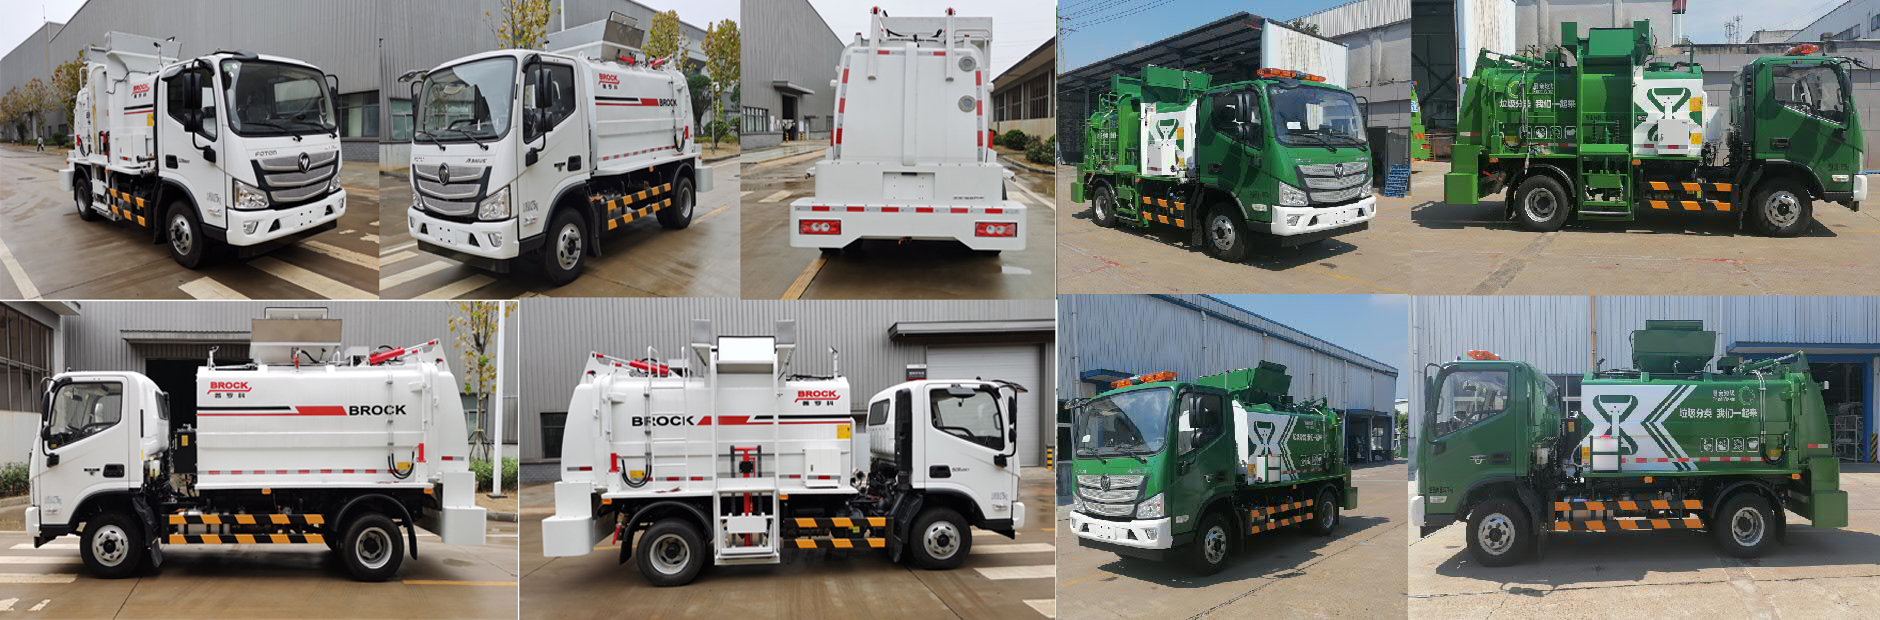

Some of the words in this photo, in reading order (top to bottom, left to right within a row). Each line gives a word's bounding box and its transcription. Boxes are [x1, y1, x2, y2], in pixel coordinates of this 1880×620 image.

[598, 73, 618, 82] BROCK
[659, 98, 678, 107] BROCK
[210, 381, 249, 390] BROCK
[797, 390, 837, 398] BROCK
[349, 404, 407, 416] BROCK
[1680, 407, 1713, 419] 垃圾分类
[1716, 407, 1758, 419] 我们一起来
[631, 415, 695, 427] BROCK
